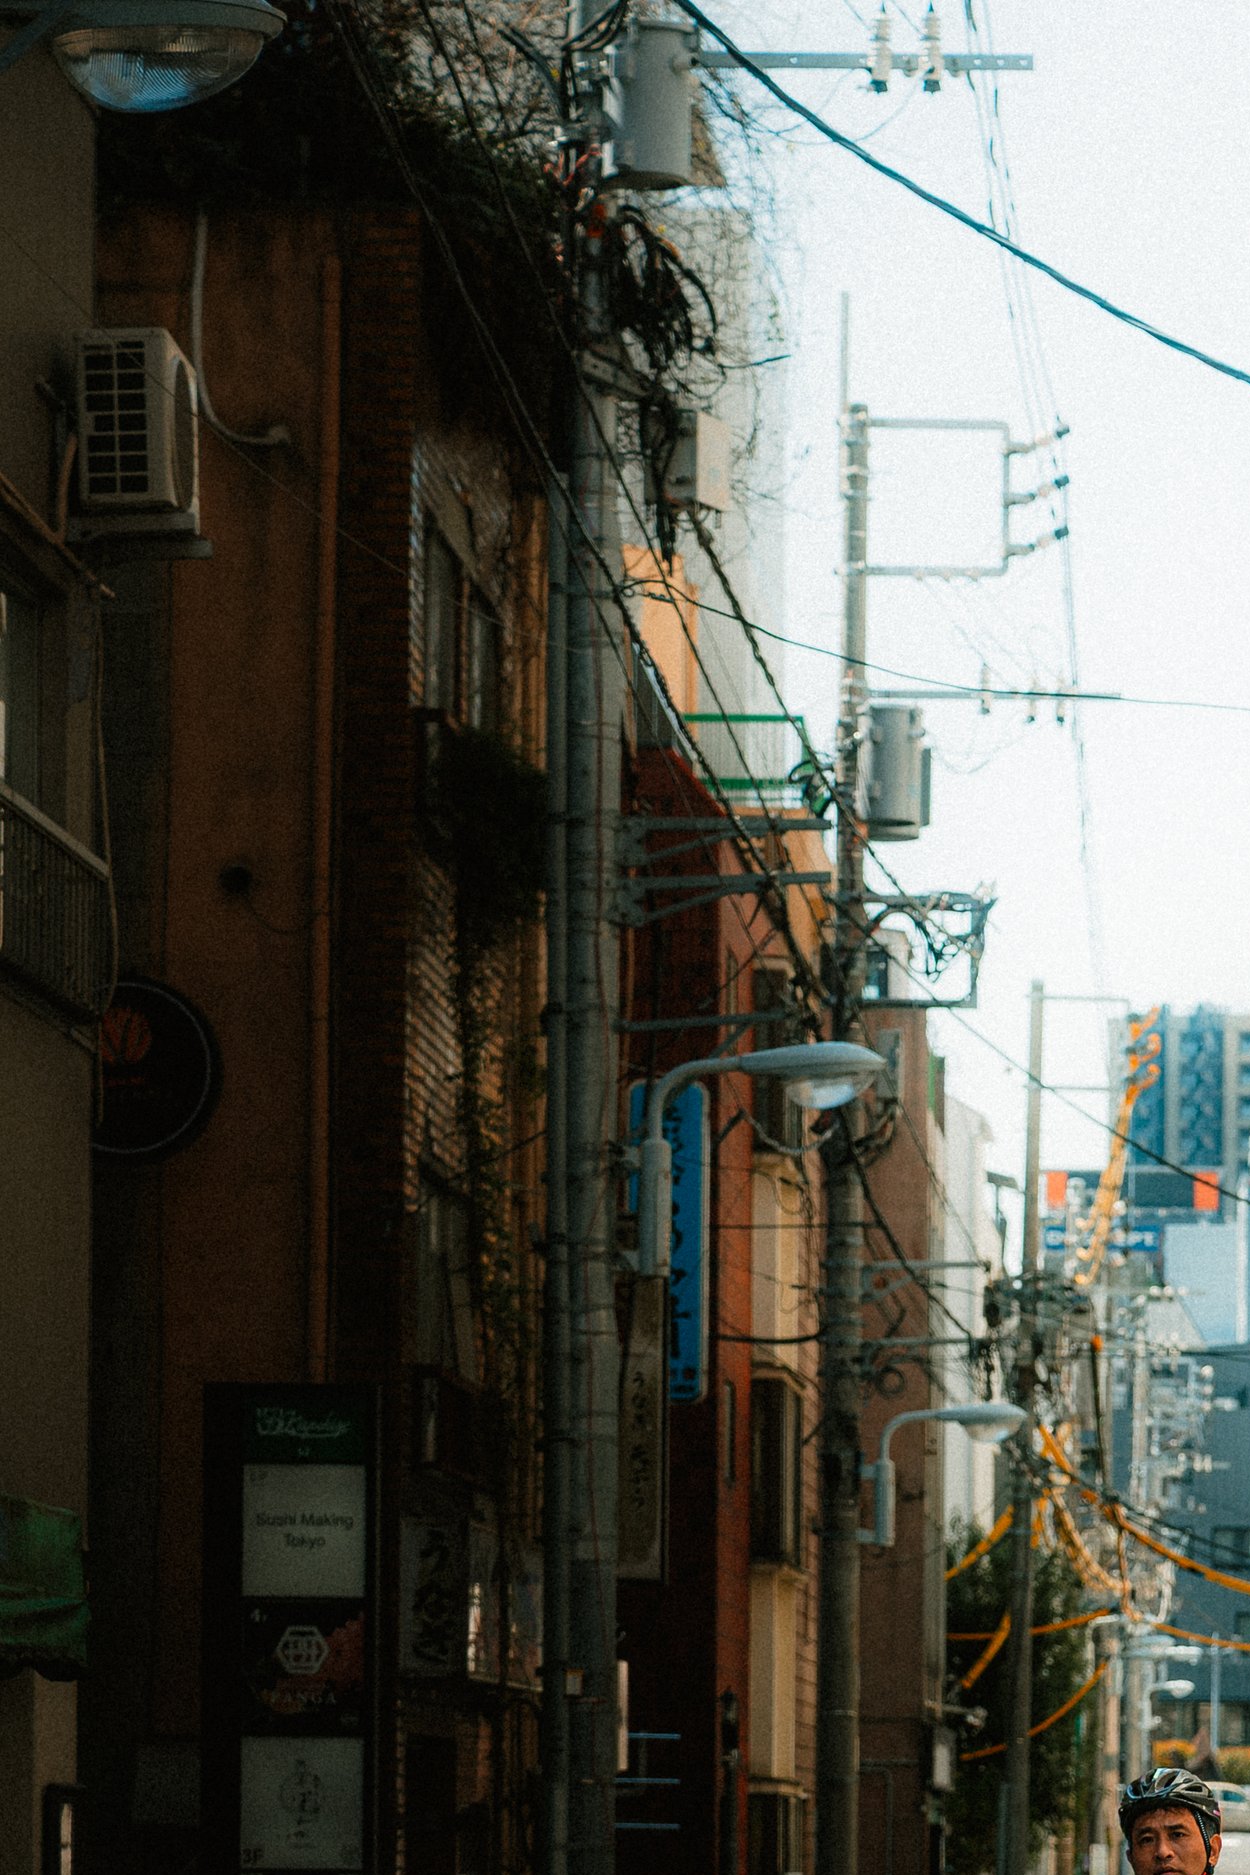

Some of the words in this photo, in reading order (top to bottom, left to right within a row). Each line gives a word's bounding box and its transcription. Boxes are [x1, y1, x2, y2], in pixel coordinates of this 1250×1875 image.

[256, 1513, 297, 1528] Sushi
[301, 1513, 354, 1531] Making
[284, 1533, 326, 1550] Tokyo
